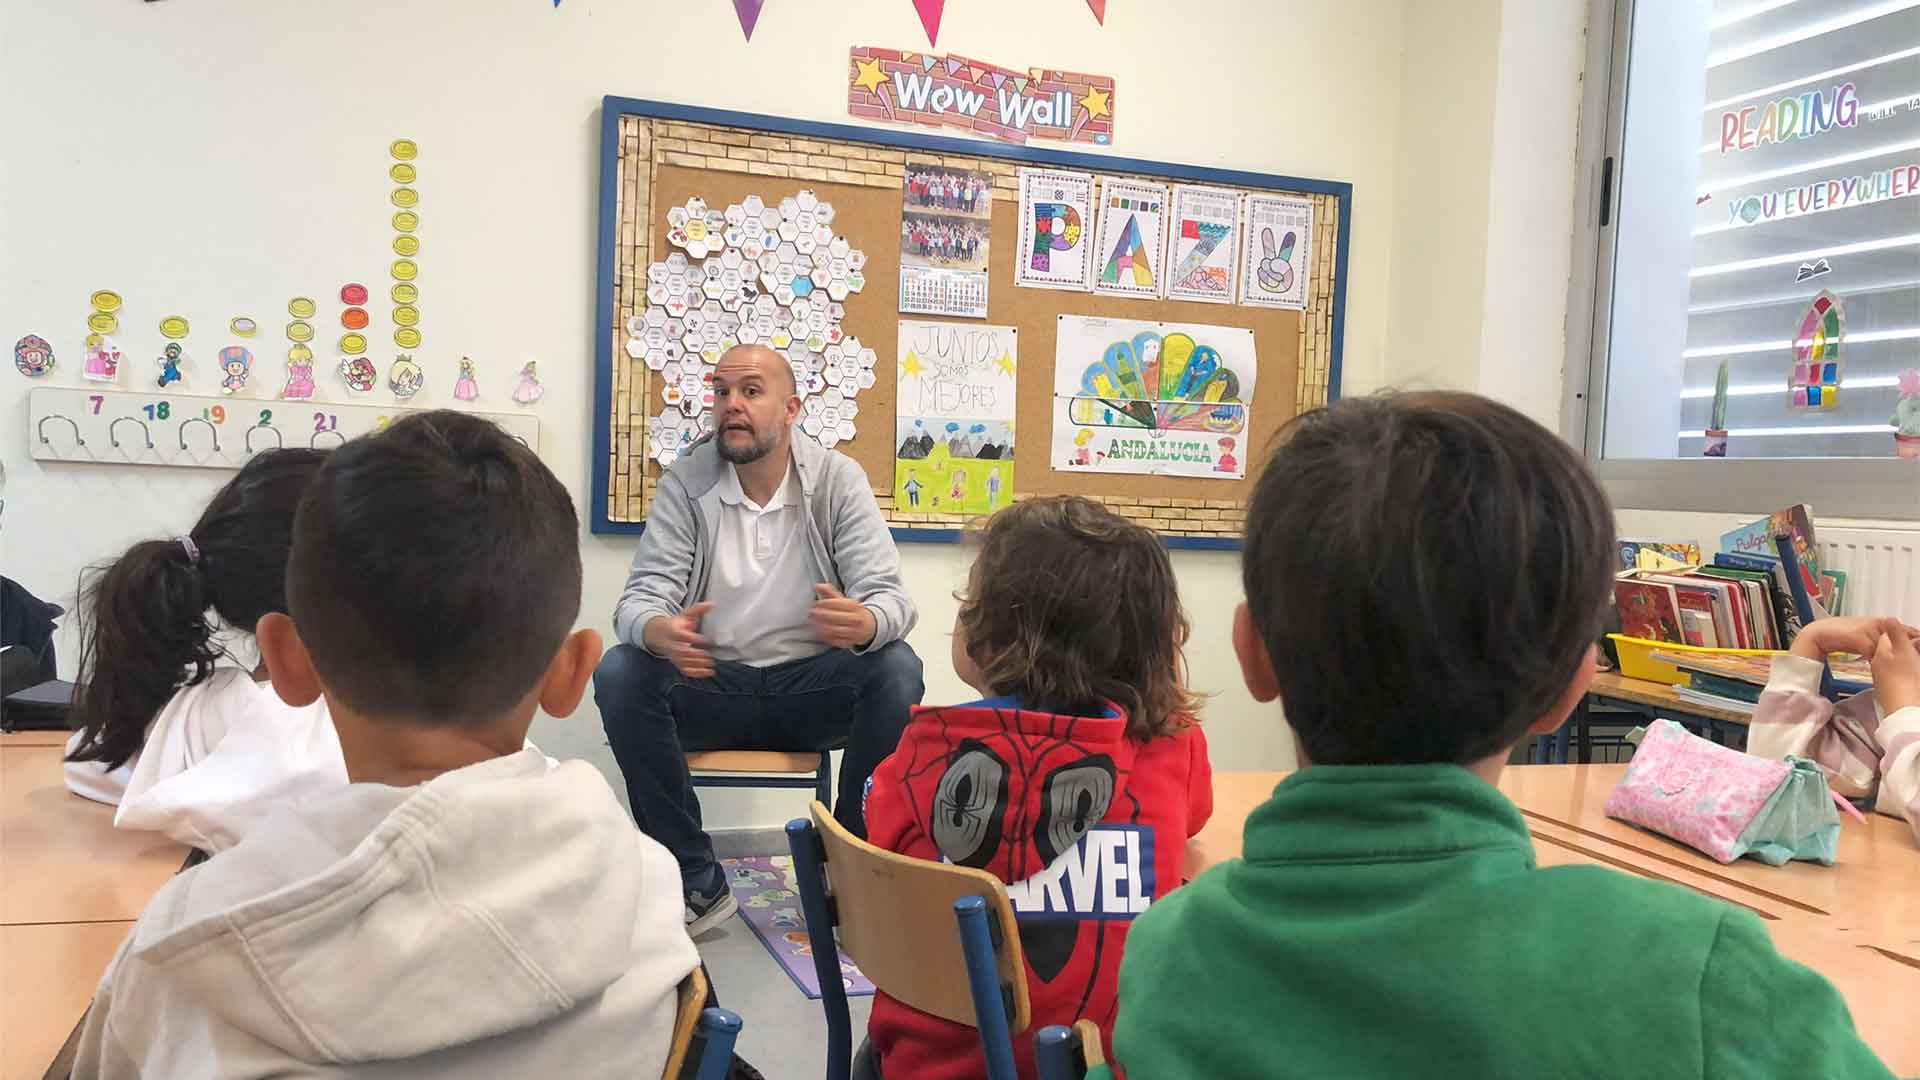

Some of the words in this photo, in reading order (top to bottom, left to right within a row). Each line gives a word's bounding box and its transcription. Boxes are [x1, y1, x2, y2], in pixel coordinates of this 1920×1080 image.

[893, 71, 985, 117] Wow
[997, 87, 1073, 130] Wall
[1721, 84, 1857, 154] READING
[143, 401, 170, 420] 18
[313, 412, 337, 432] 21
[1107, 438, 1213, 464] ANDALUCIA
